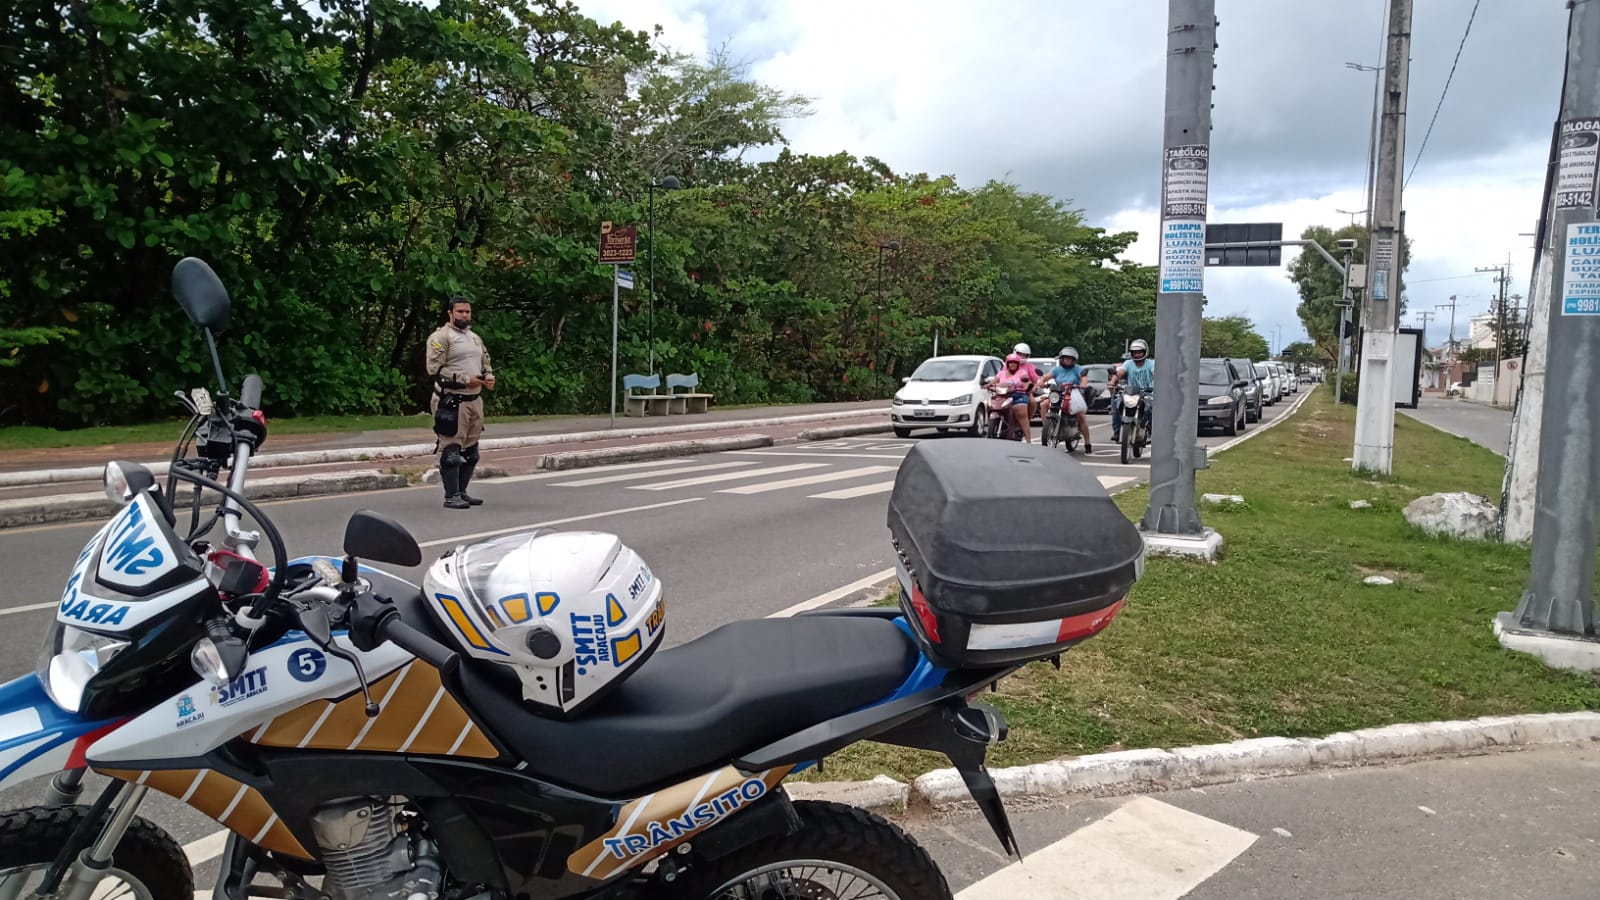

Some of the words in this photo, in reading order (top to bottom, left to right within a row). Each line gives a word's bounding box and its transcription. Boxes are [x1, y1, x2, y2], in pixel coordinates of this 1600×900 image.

[1168, 223, 1202, 231] TERAPIA
[1166, 240, 1203, 248] LUANA
[570, 612, 598, 666] SMTT
[593, 614, 610, 662] ARACAJU
[298, 652, 317, 676] 5
[218, 666, 268, 704] SMTT
[176, 711, 205, 728] ARACAJU
[603, 778, 767, 860] TRÂNSITO
